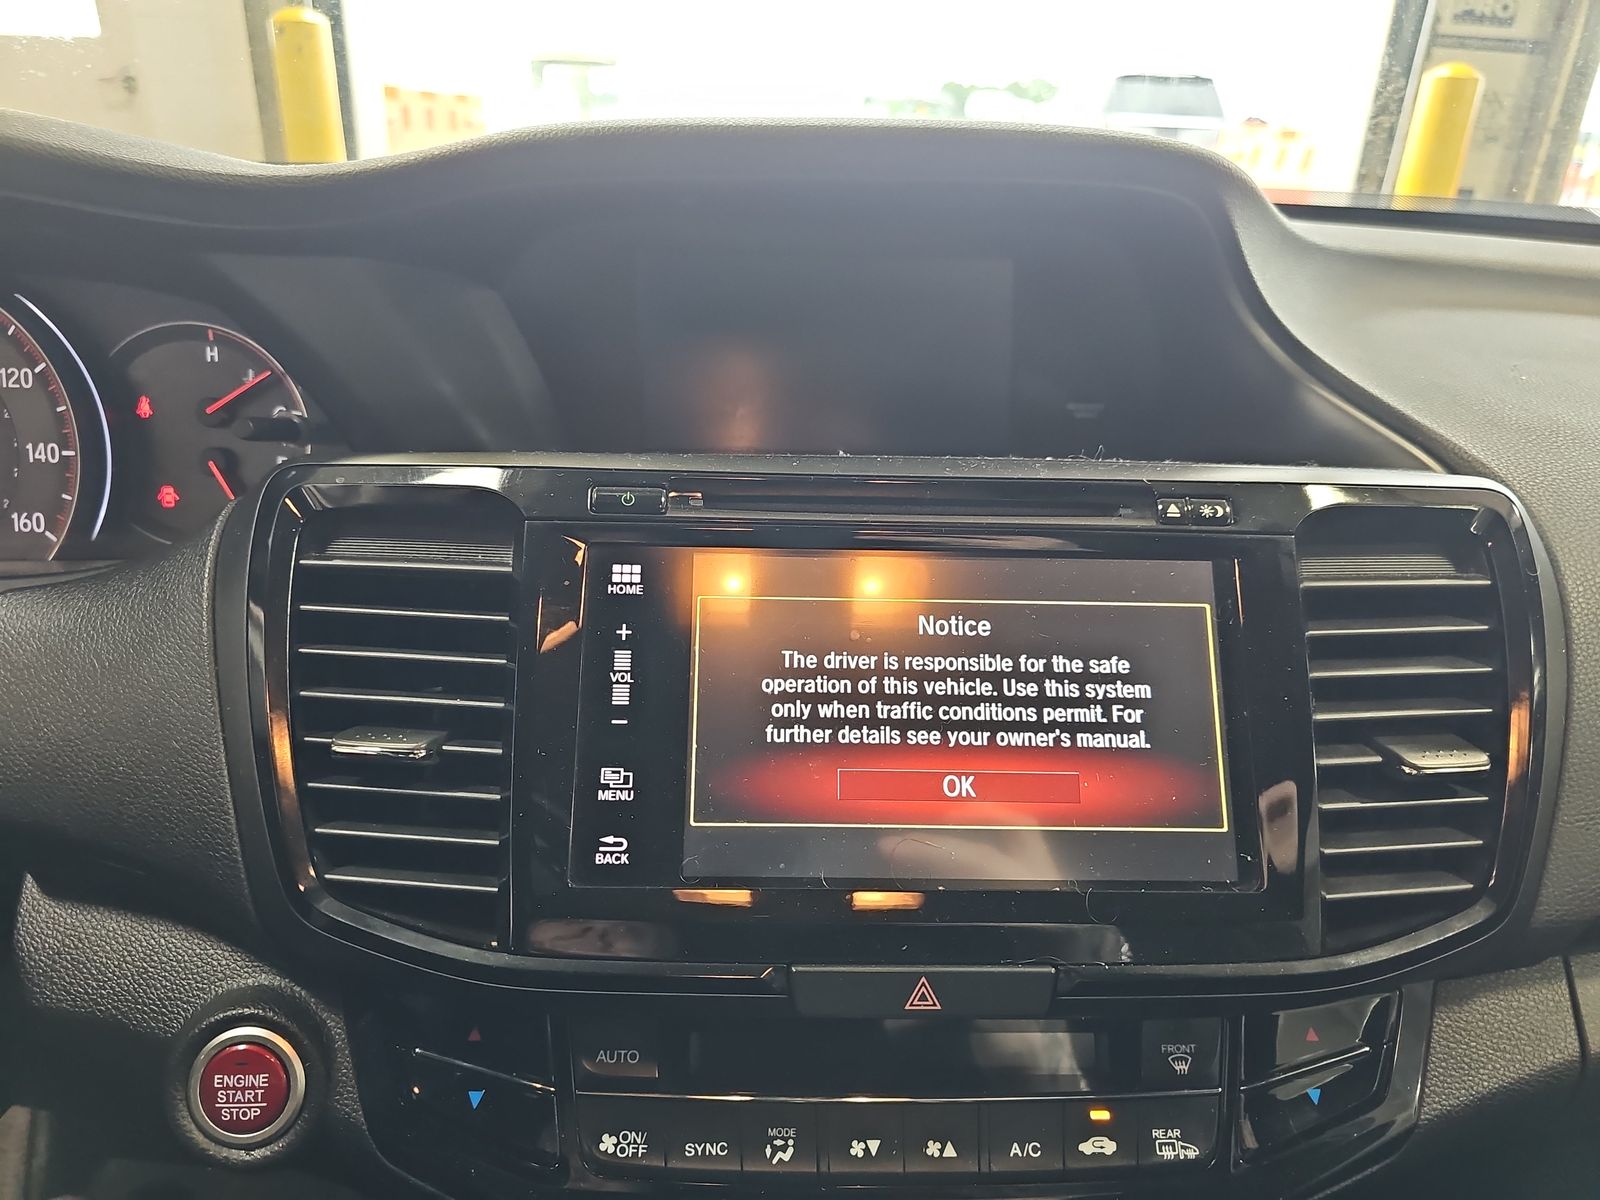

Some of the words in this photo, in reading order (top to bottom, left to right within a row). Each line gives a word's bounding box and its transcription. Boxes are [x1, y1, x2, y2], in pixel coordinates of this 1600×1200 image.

[206, 346, 218, 362] H
[0, 368, 32, 388] 120
[26, 443, 59, 463] 140
[11, 512, 45, 532] 160
[607, 585, 644, 595] HOME
[918, 615, 991, 637] Notice
[782, 651, 817, 669] The
[824, 651, 878, 670] driver
[884, 653, 899, 670] is
[904, 653, 1013, 673] responsible
[1019, 655, 1046, 673] for
[1052, 655, 1083, 673] the
[1089, 655, 1131, 674] safe
[610, 673, 634, 683] VOL
[761, 676, 852, 696] operation
[858, 676, 878, 694] of
[883, 677, 918, 695] this
[924, 678, 998, 697] vehicle.
[1003, 679, 1038, 697] Use
[1044, 679, 1080, 698] this
[1085, 681, 1152, 700] system
[771, 702, 812, 720] only
[818, 702, 870, 720] when
[876, 702, 933, 721] traffic
[938, 703, 1037, 722] conditions
[1043, 704, 1107, 724] permit.
[1113, 705, 1144, 724] For
[765, 725, 832, 743] further
[838, 726, 901, 745] details
[906, 730, 941, 745] see
[947, 730, 990, 748] your
[996, 729, 1071, 748] owner's
[1076, 730, 1151, 749] manual.
[942, 775, 976, 798] OK
[598, 790, 634, 801] MENU
[595, 853, 629, 864] BACK
[1161, 1044, 1196, 1053] FRONT
[596, 1050, 640, 1063] AUTO
[214, 1074, 269, 1088] ENGINE
[217, 1090, 264, 1103] START
[221, 1108, 260, 1120] STOP
[619, 1131, 647, 1144] ON/
[768, 1127, 796, 1137] MODE
[1152, 1129, 1181, 1138] REAR
[616, 1144, 648, 1157] OFF
[684, 1142, 728, 1156] SYNC
[1009, 1142, 1041, 1158] A/C
